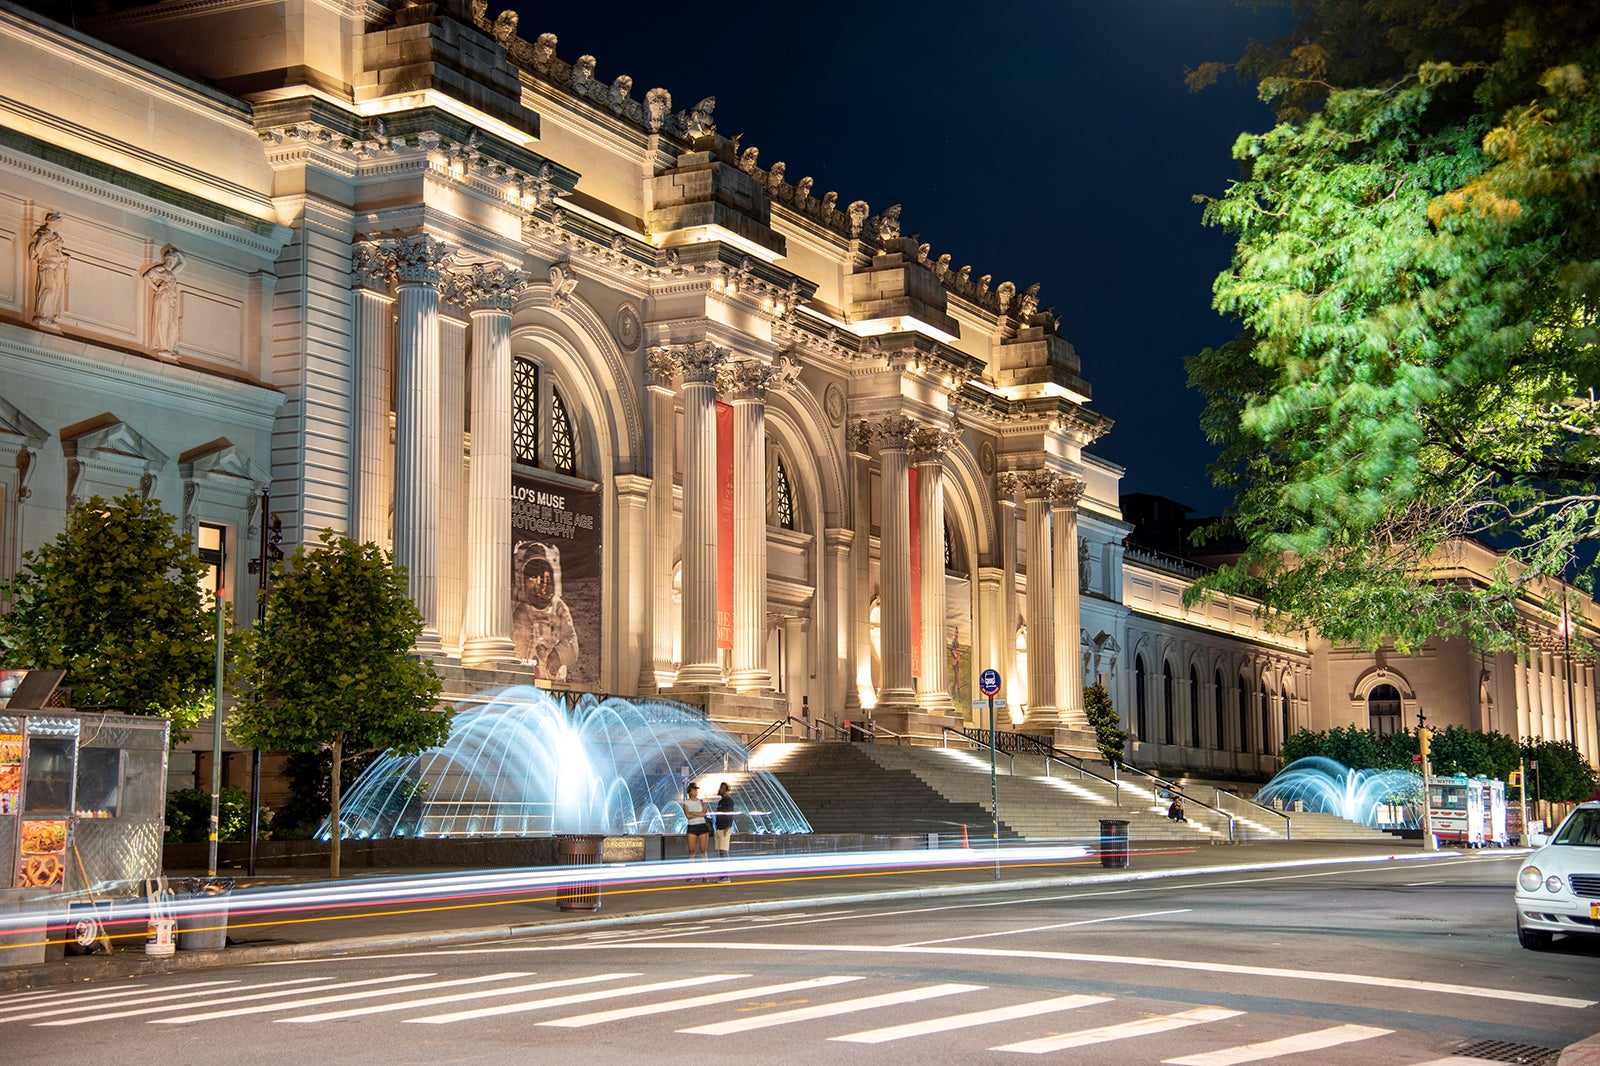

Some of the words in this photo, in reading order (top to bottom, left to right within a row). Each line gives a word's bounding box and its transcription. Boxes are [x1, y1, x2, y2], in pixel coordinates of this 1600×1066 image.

[511, 485, 535, 503] LO'S
[537, 491, 565, 510] MUSE
[511, 513, 576, 539] HOTOGRAPHY
[541, 505, 553, 521] IN
[553, 508, 573, 526] THE
[574, 513, 594, 530] AGE
[611, 840, 626, 848] Koch
[626, 840, 643, 848] Plaza
